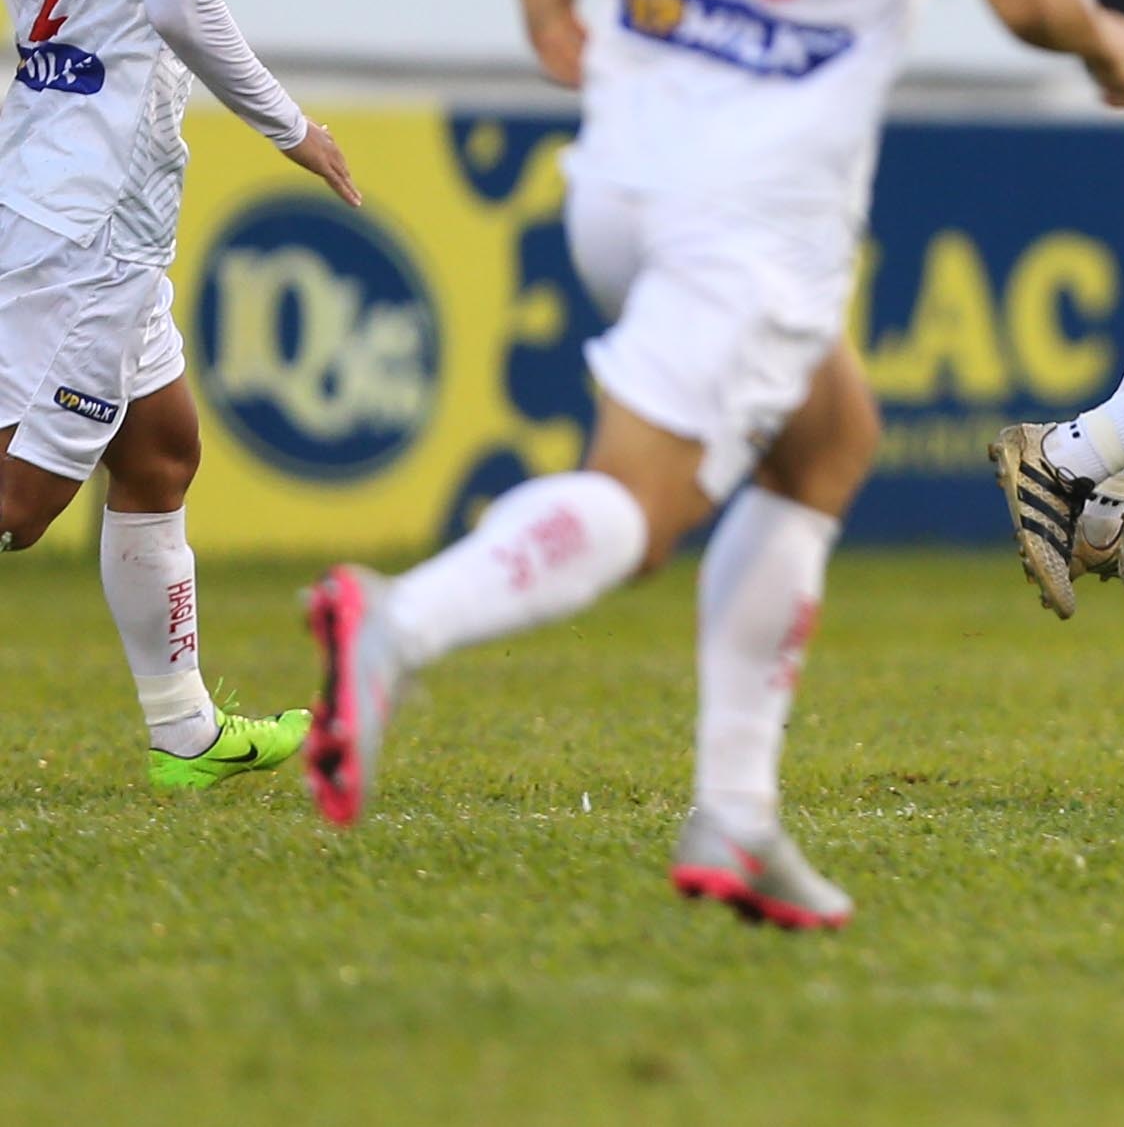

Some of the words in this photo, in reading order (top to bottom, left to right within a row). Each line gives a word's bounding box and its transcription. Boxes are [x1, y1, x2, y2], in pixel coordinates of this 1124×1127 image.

[59, 389, 117, 421] VPMILK
[166, 578, 193, 634] HAGL
[169, 632, 195, 663] FC
